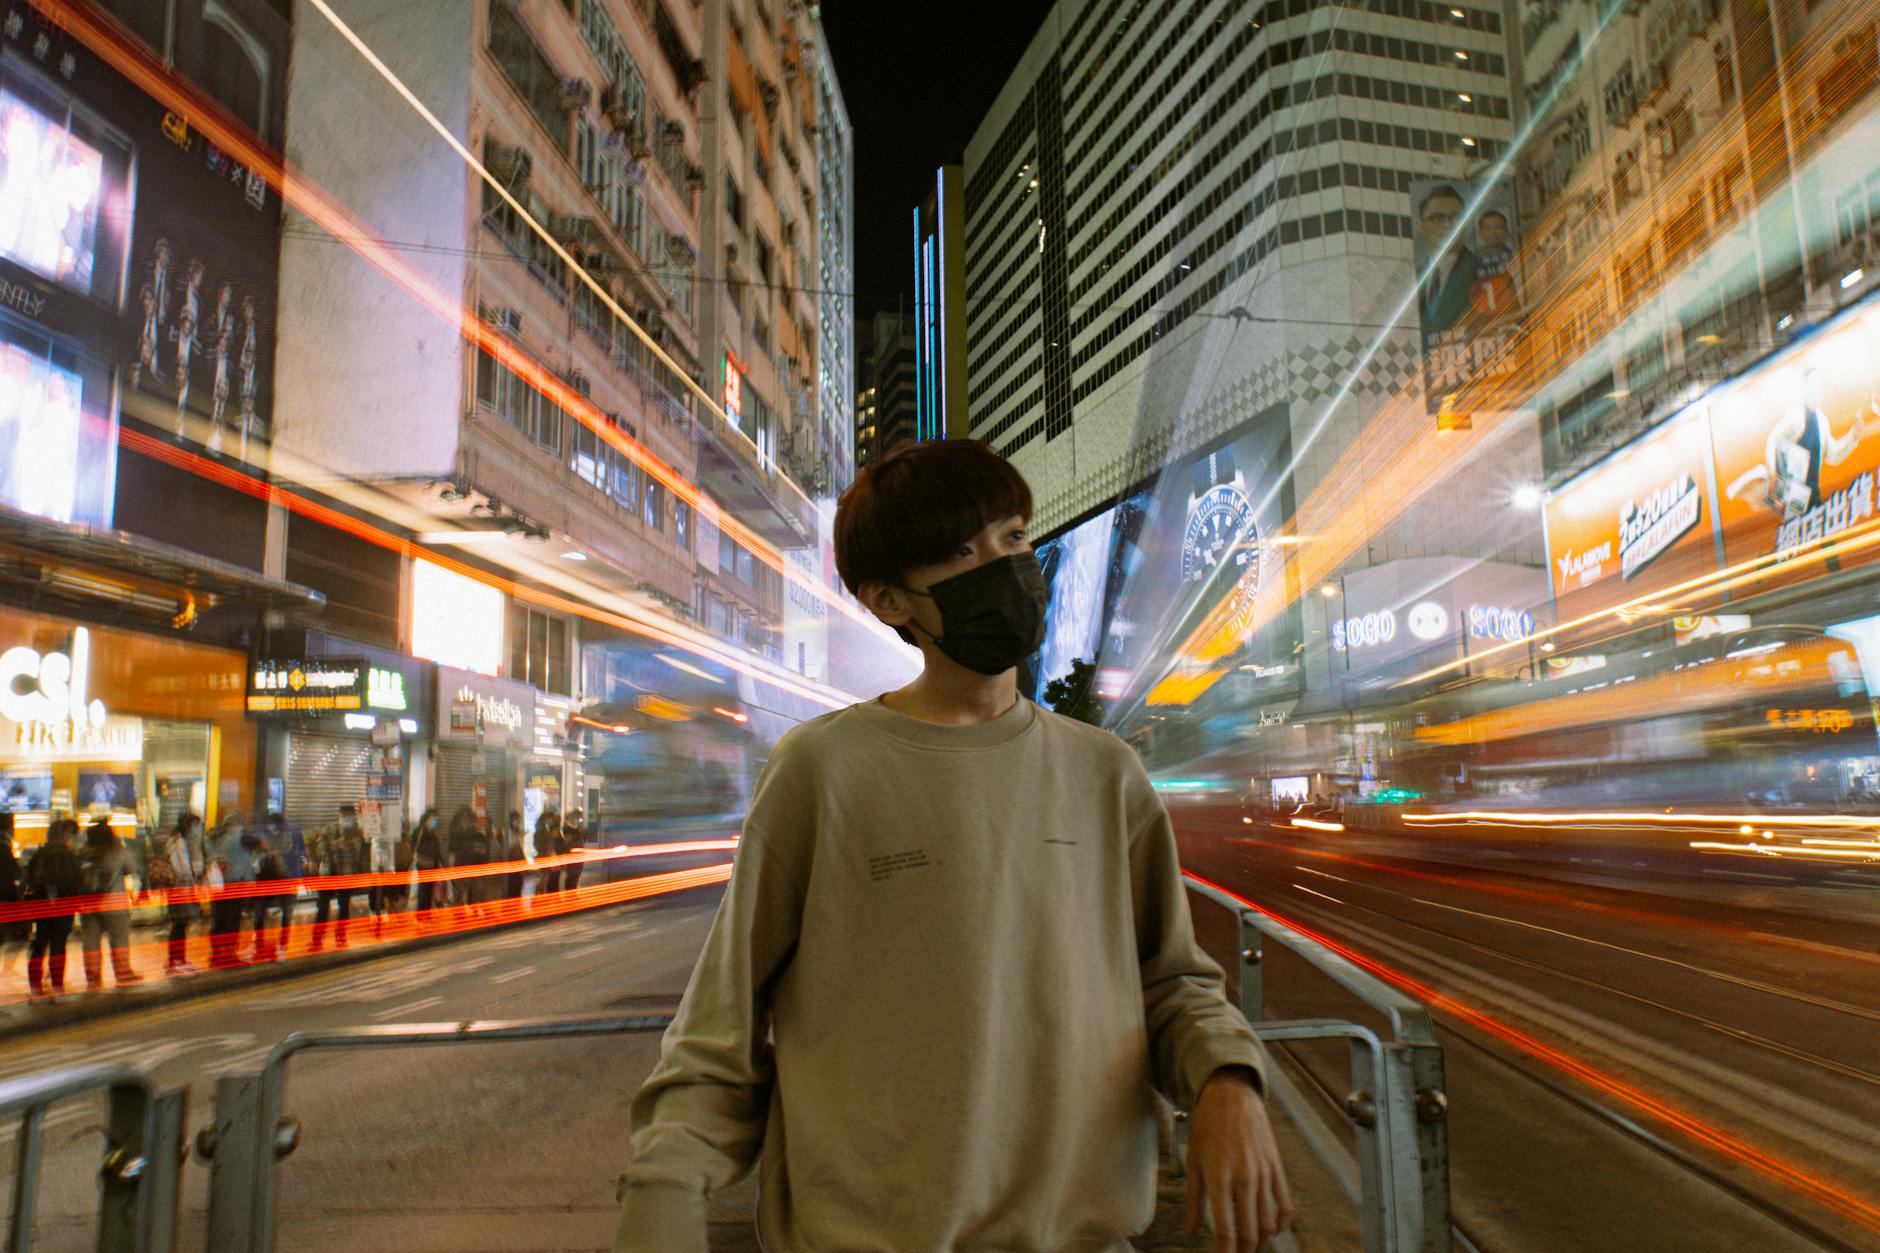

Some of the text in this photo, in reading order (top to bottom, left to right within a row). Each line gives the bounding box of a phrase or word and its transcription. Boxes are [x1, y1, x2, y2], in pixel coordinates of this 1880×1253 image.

[1332, 609, 1395, 651] SOGO
[1470, 604, 1535, 642] SOGO
[0, 626, 106, 733] csl.
